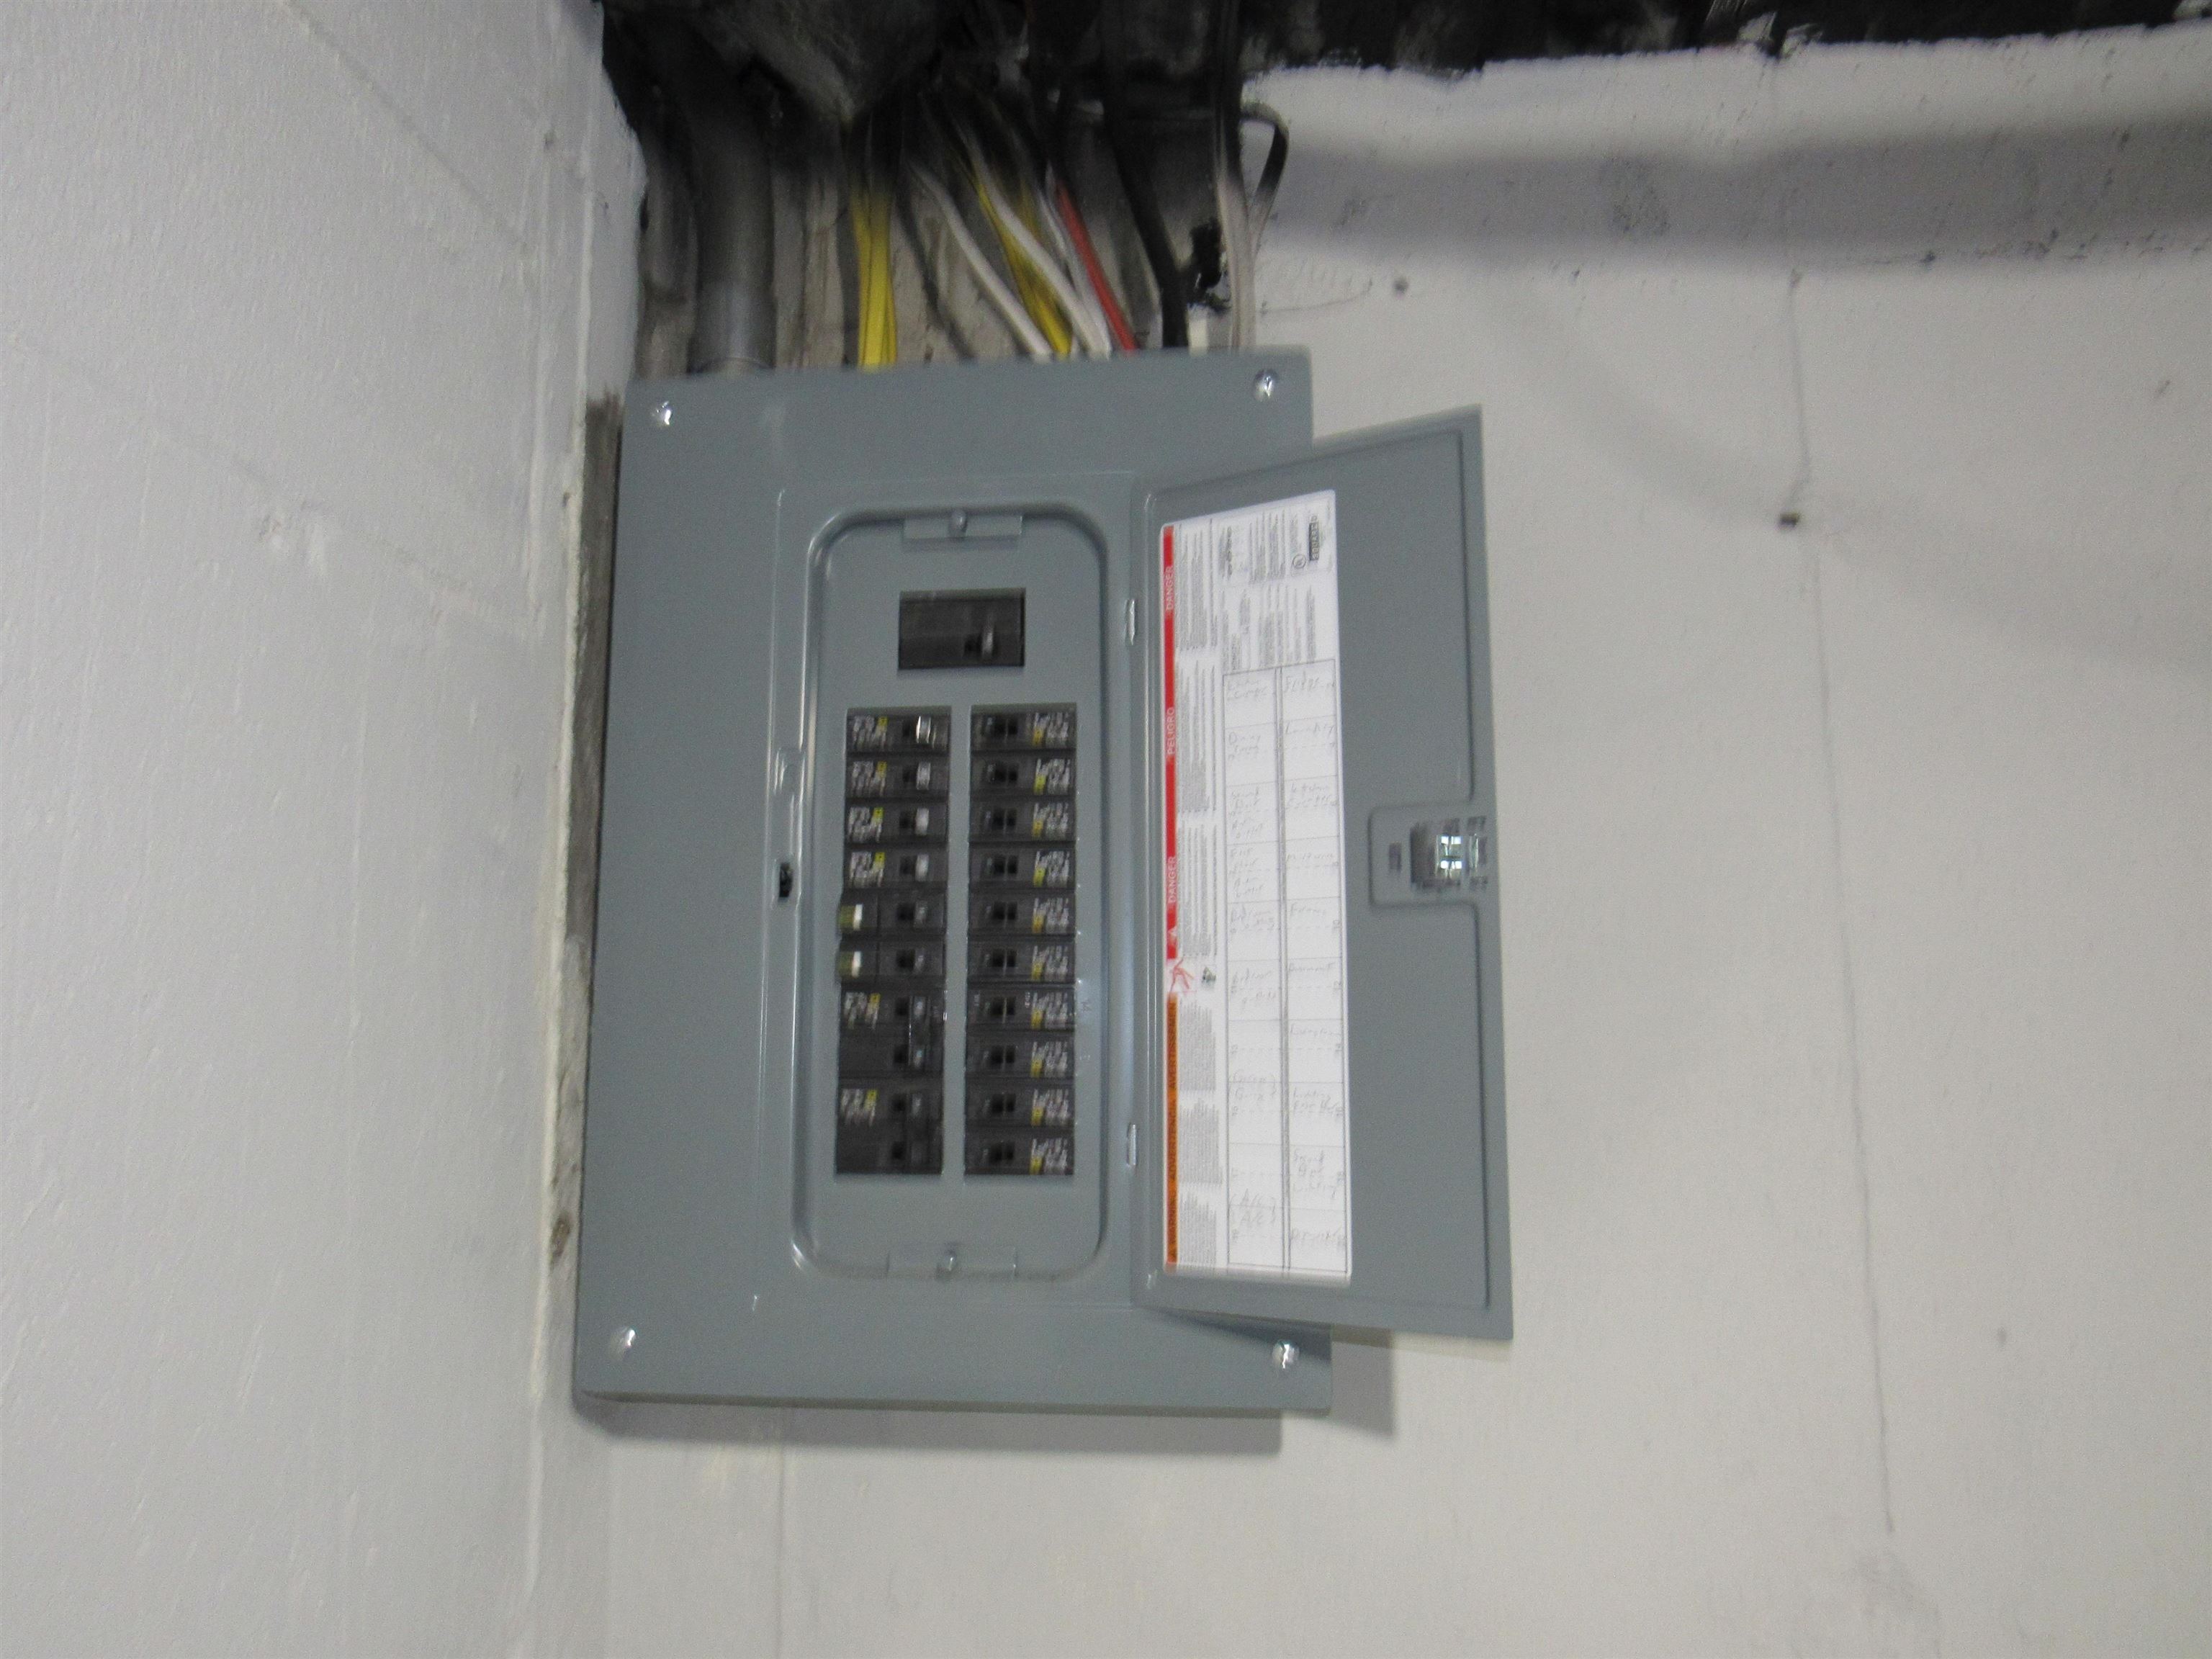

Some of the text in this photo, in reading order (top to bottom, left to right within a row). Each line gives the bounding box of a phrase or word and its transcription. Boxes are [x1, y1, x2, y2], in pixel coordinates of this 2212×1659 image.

[1165, 566, 1174, 611] DANGER
[1166, 706, 1175, 755] PELIGRO
[1167, 856, 1177, 904] DANGER
